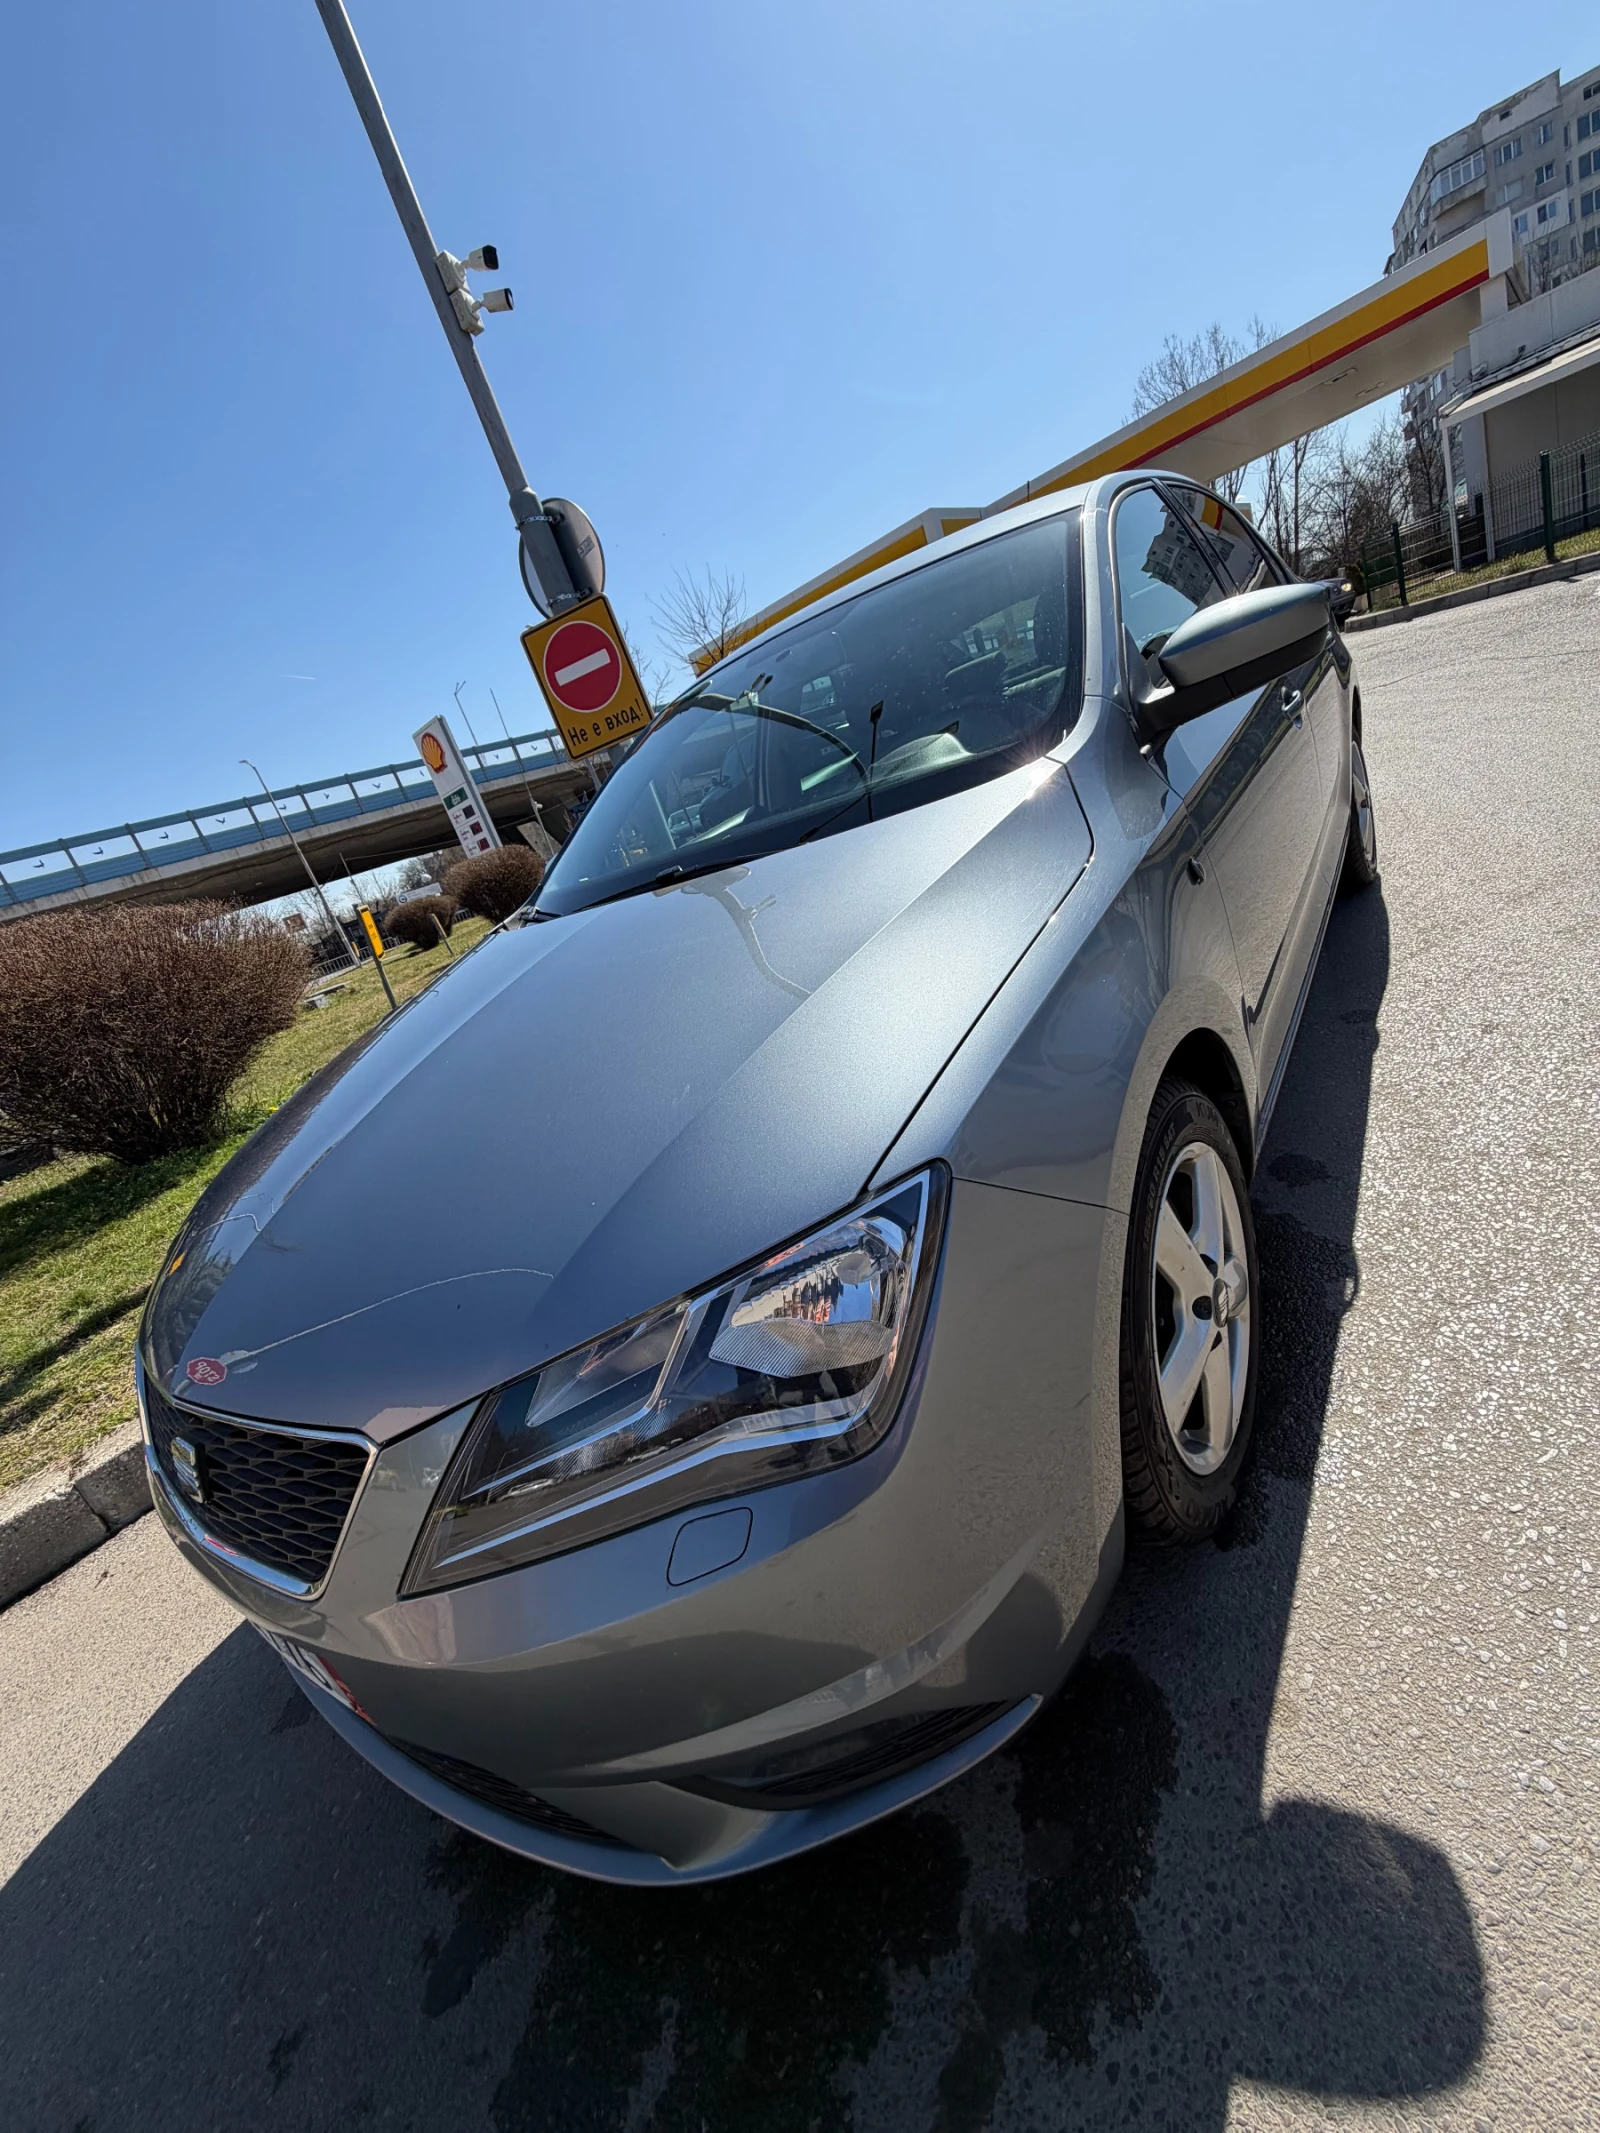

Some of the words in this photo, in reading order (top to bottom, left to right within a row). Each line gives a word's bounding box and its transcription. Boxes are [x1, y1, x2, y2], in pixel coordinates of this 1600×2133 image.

[567, 726, 589, 747] Не
[592, 722, 602, 737] е
[604, 698, 644, 731] вход!
